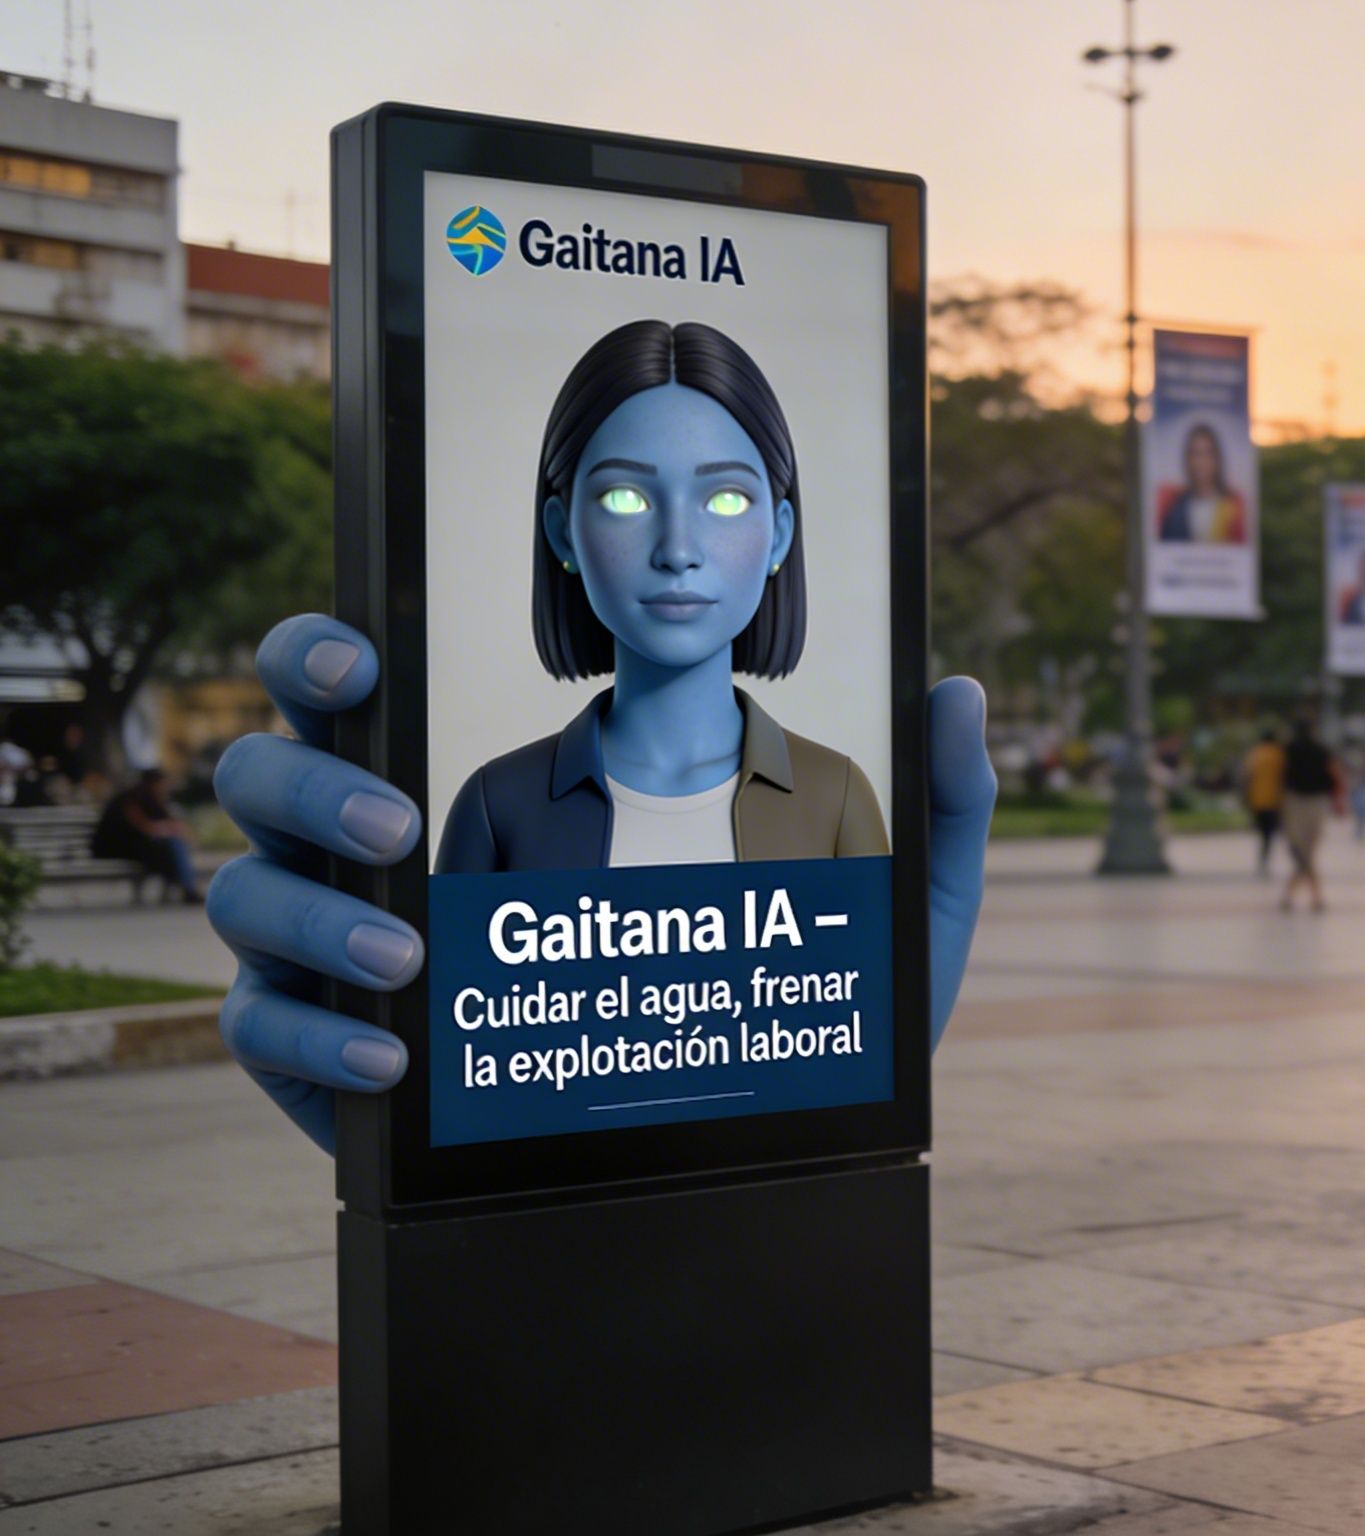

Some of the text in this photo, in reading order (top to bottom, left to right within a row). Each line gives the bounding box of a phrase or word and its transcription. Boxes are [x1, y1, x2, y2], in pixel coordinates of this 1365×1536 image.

[519, 219, 745, 285] Gaitana IA
[488, 896, 726, 965] Gaitana
[744, 888, 803, 948] IA
[453, 966, 859, 1031] Cuidar el agua, frenar
[464, 1011, 863, 1091] la explotación laboral
